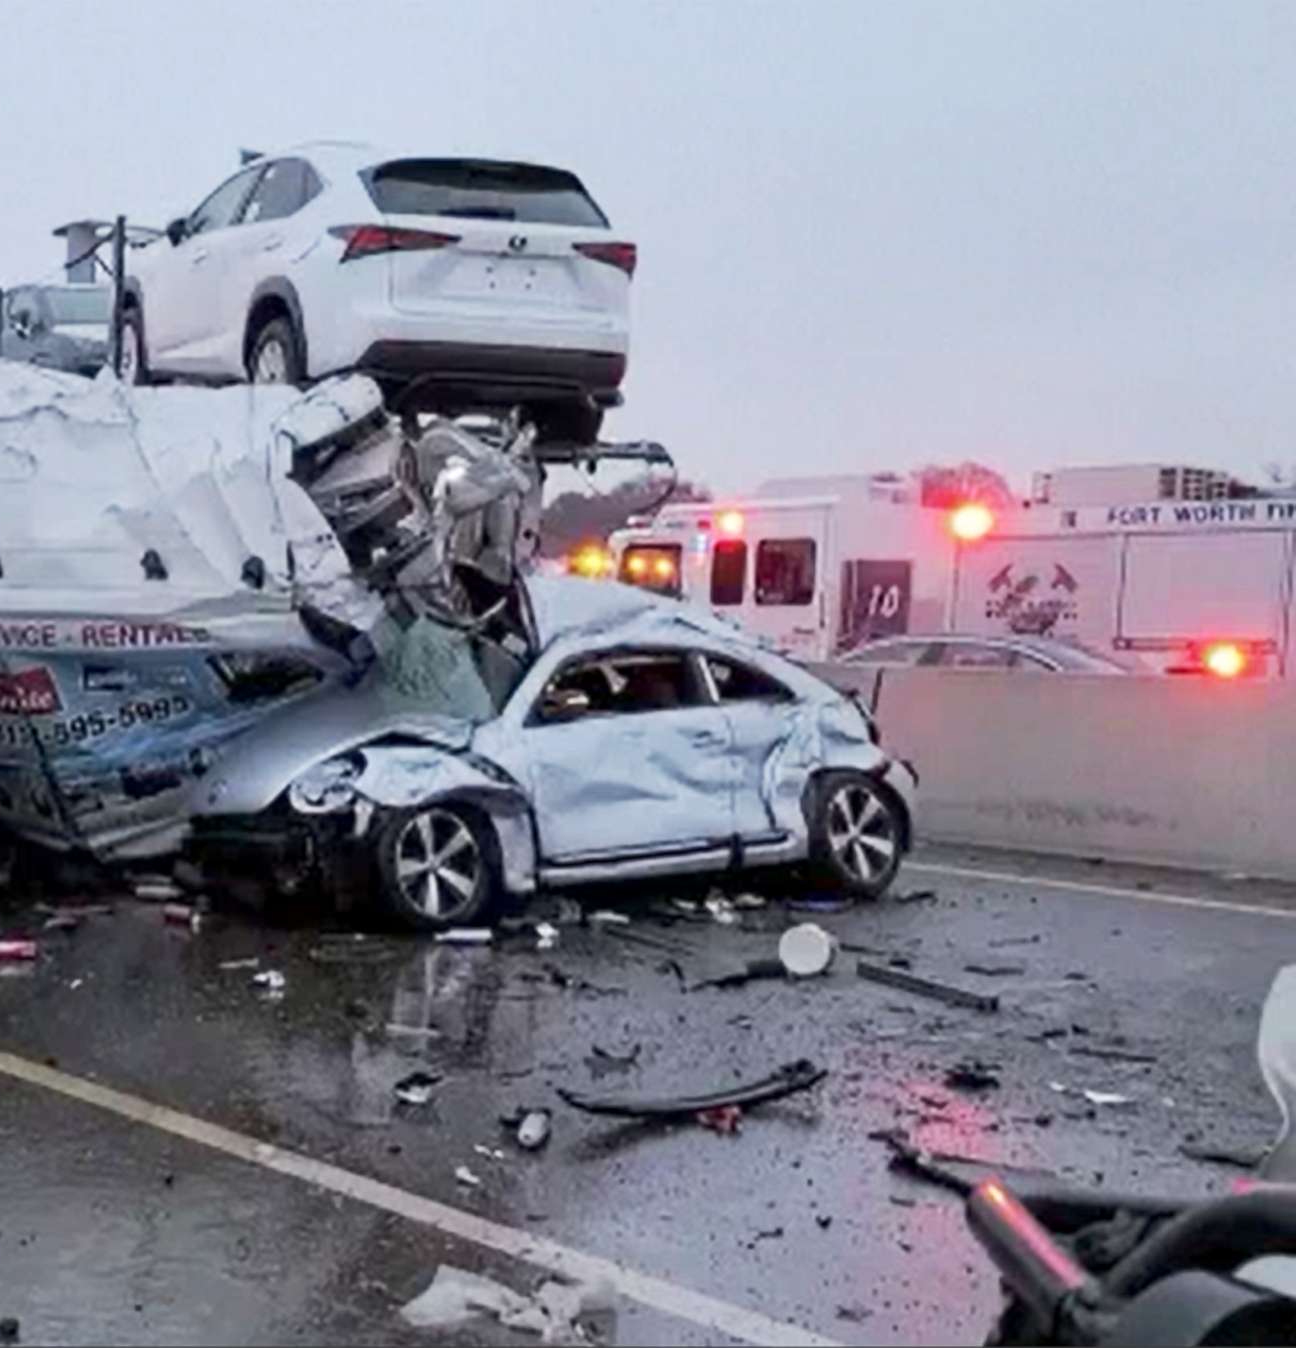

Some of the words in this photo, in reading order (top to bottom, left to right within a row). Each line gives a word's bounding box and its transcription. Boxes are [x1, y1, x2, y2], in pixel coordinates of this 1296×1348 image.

[1106, 506, 1160, 525] FORT
[1173, 503, 1254, 523] WORTH
[867, 584, 900, 618] 10
